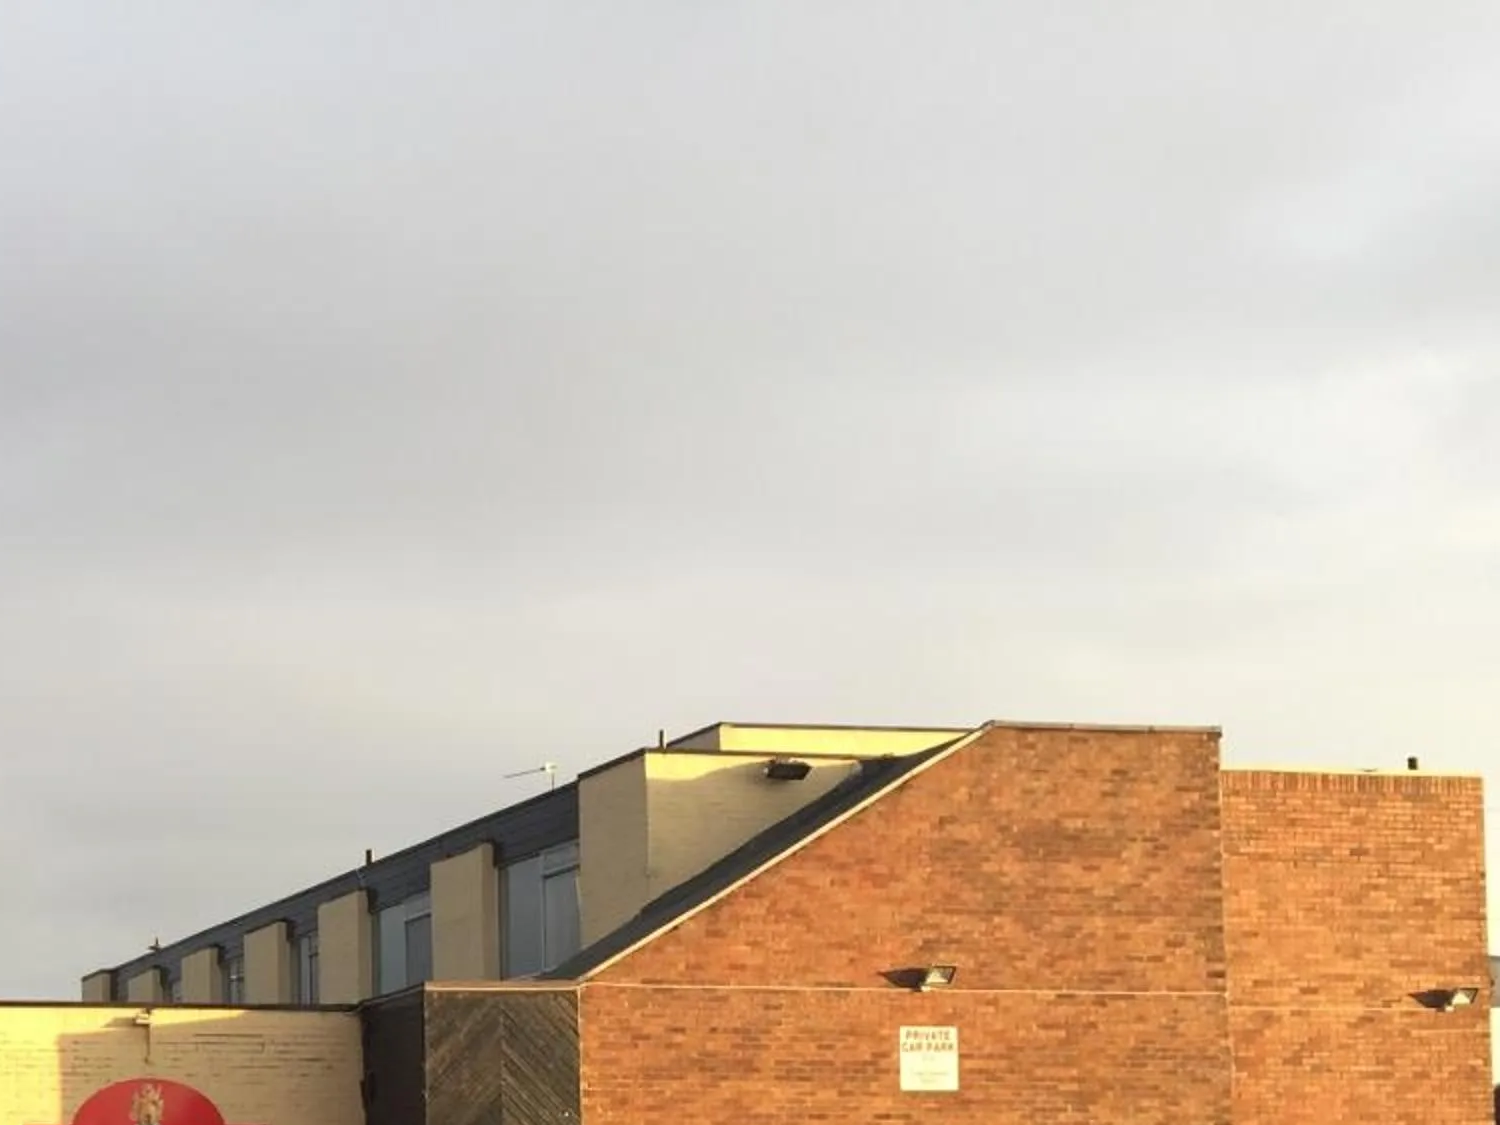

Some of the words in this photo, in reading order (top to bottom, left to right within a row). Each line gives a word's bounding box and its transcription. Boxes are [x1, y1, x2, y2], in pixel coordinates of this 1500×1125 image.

[905, 1030, 951, 1041] PRIVATE
[901, 1042, 923, 1053] CAR
[925, 1042, 955, 1053] PARK
